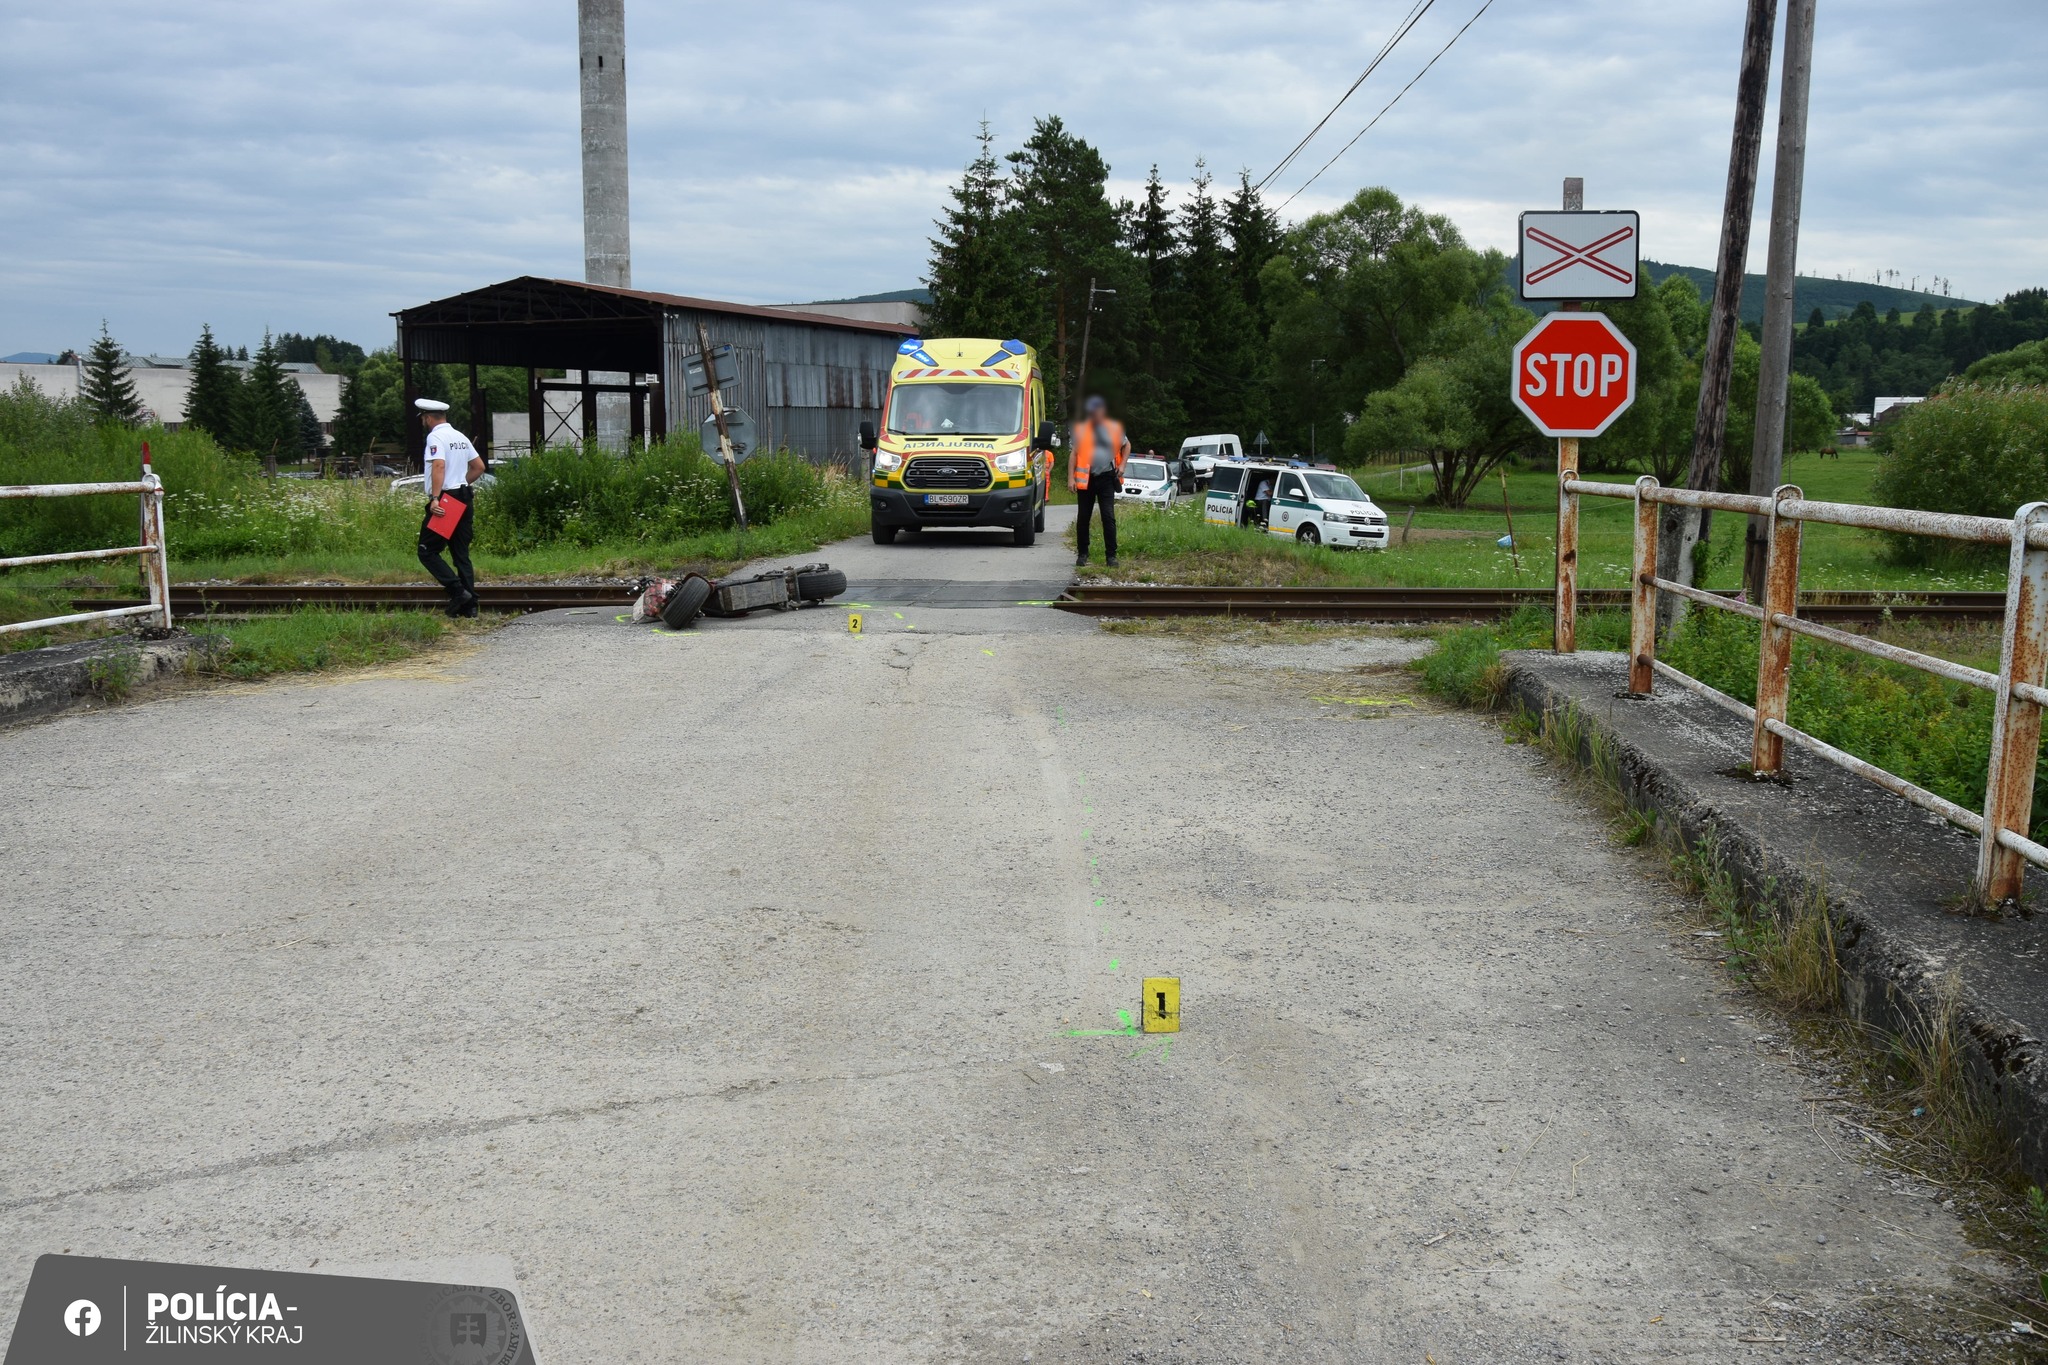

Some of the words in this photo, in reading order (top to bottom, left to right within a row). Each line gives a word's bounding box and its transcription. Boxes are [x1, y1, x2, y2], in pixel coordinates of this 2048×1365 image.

[1525, 352, 1622, 398] STOP
[1206, 504, 1233, 515] POLÍCIA
[852, 618, 858, 628] 2
[1156, 992, 1170, 1019] 1
